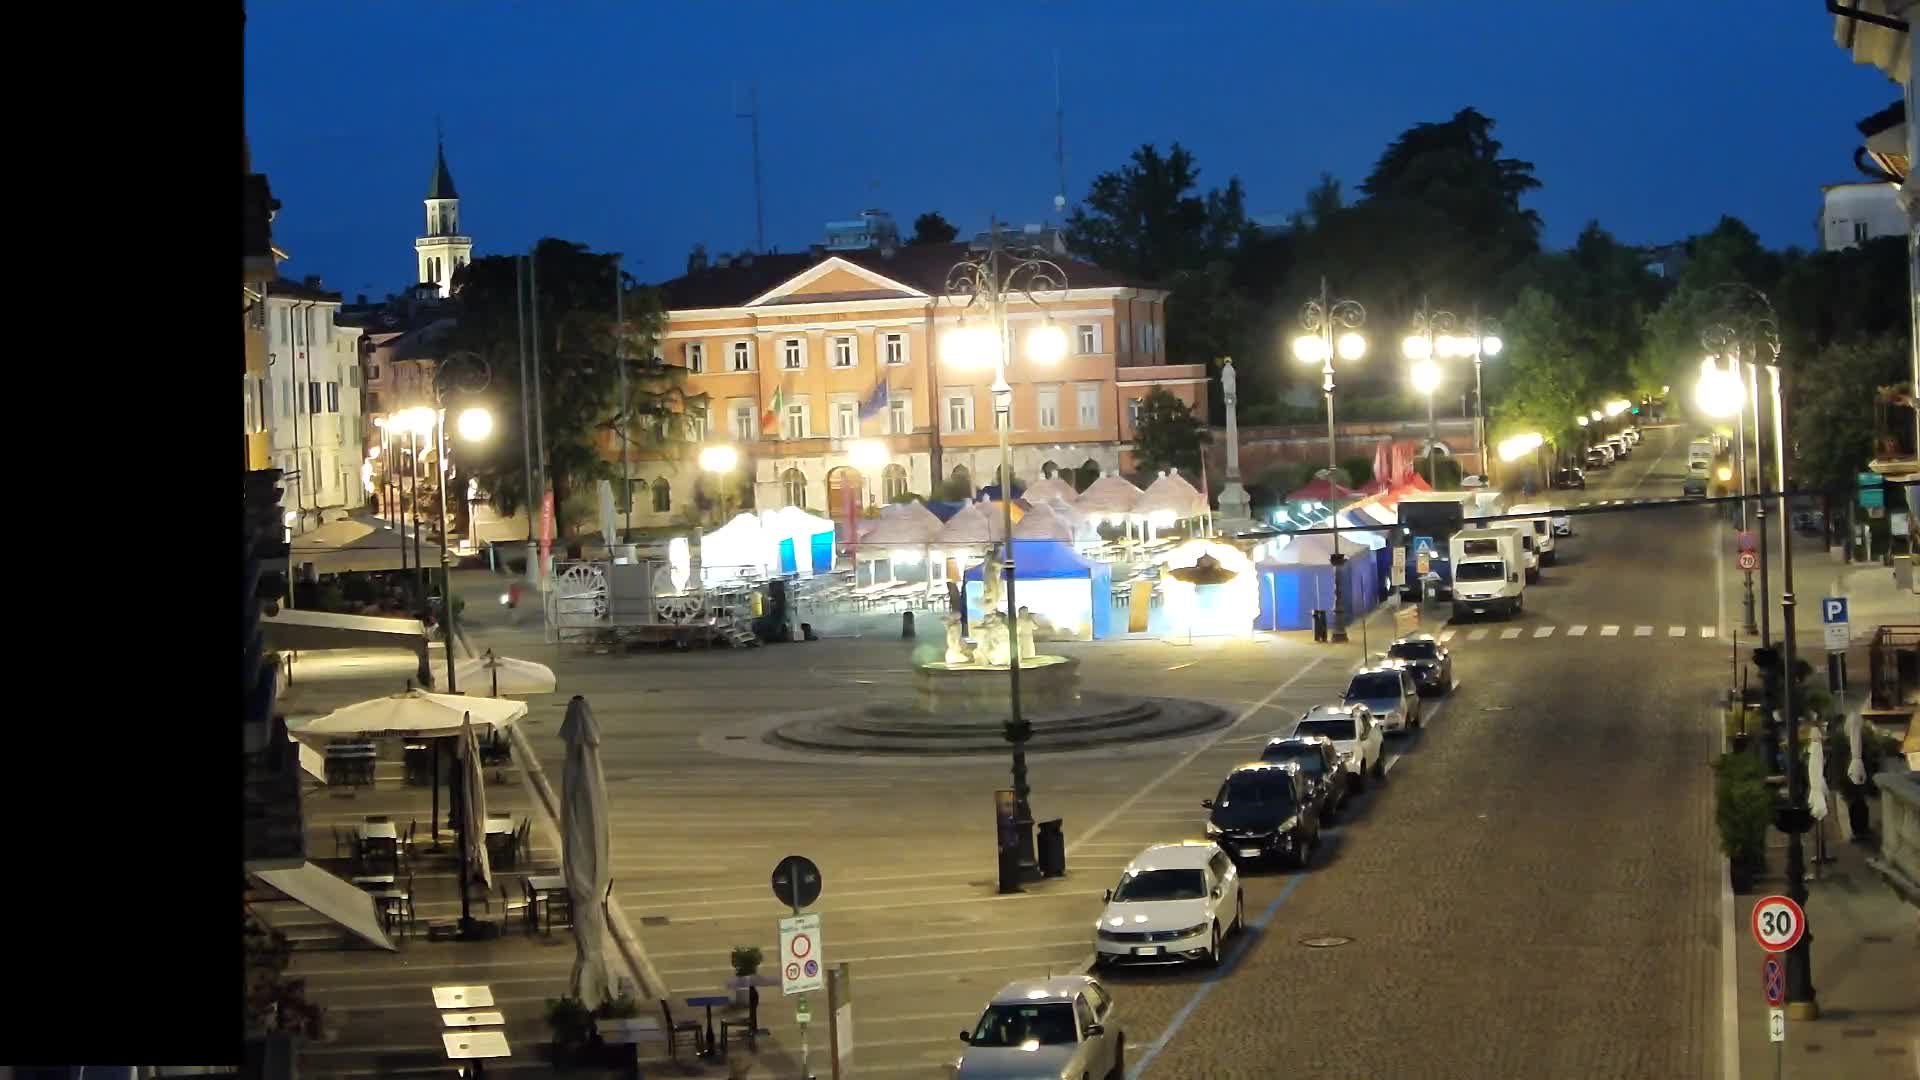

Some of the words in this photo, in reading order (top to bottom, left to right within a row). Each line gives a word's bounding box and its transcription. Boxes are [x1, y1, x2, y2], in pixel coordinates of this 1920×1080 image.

[1743, 557, 1753, 566] 20
[1827, 600, 1843, 621] P
[1762, 910, 1792, 937] 30
